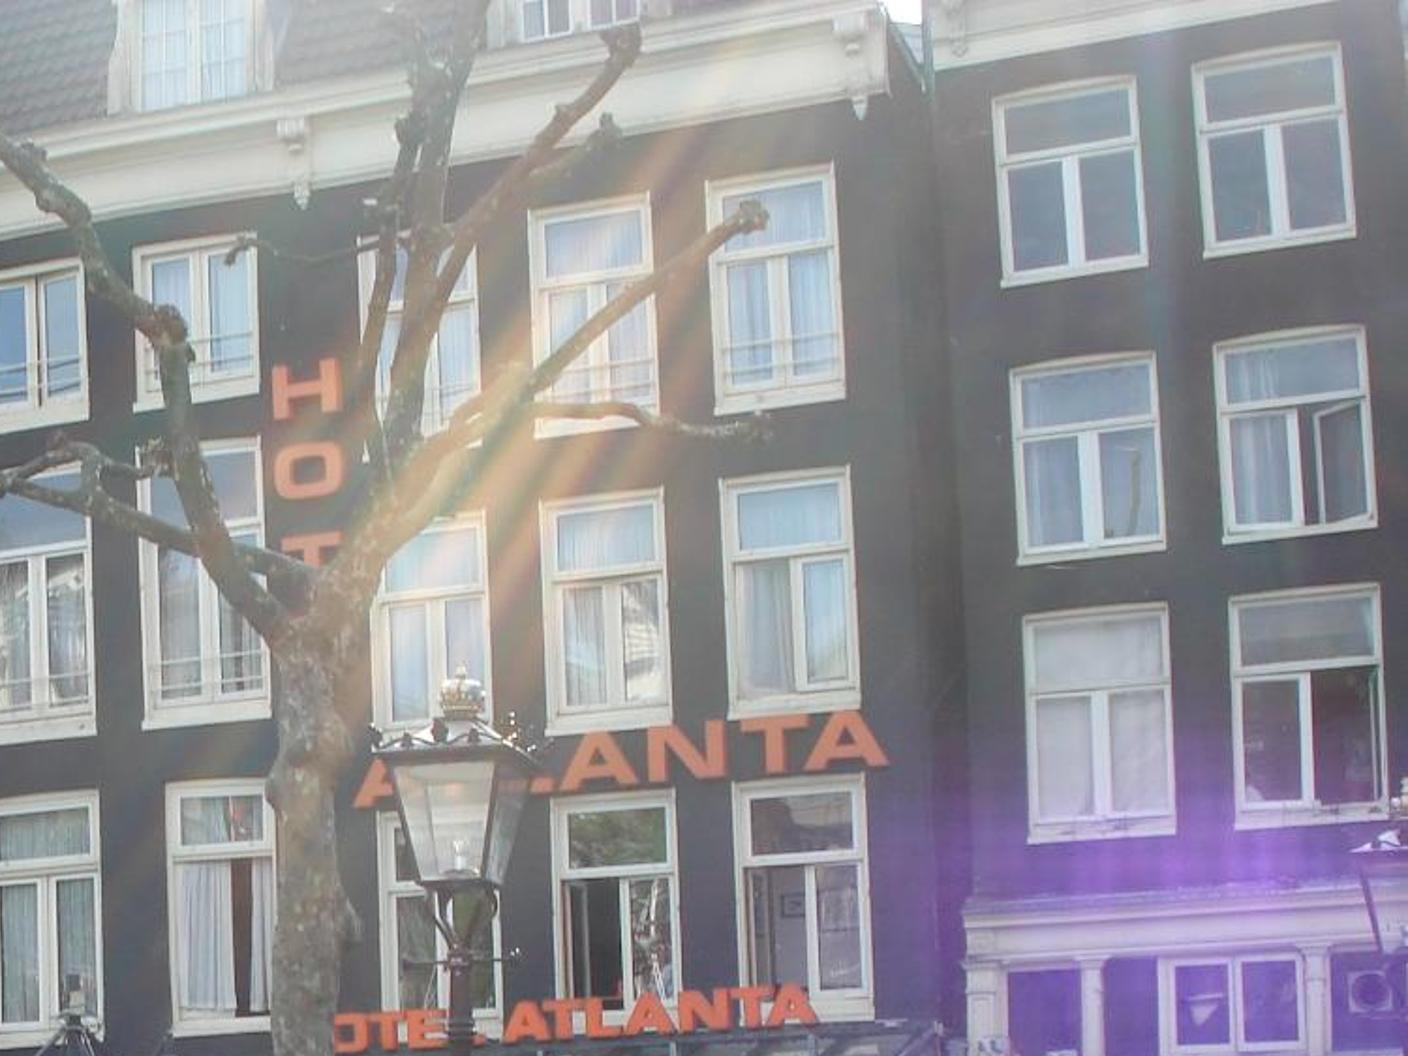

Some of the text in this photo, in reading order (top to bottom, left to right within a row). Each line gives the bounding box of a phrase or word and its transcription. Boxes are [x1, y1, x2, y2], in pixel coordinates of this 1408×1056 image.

[272, 358, 343, 568] HOT
[354, 709, 890, 810] AANTA
[333, 983, 819, 1055] OTE ATLANTA
